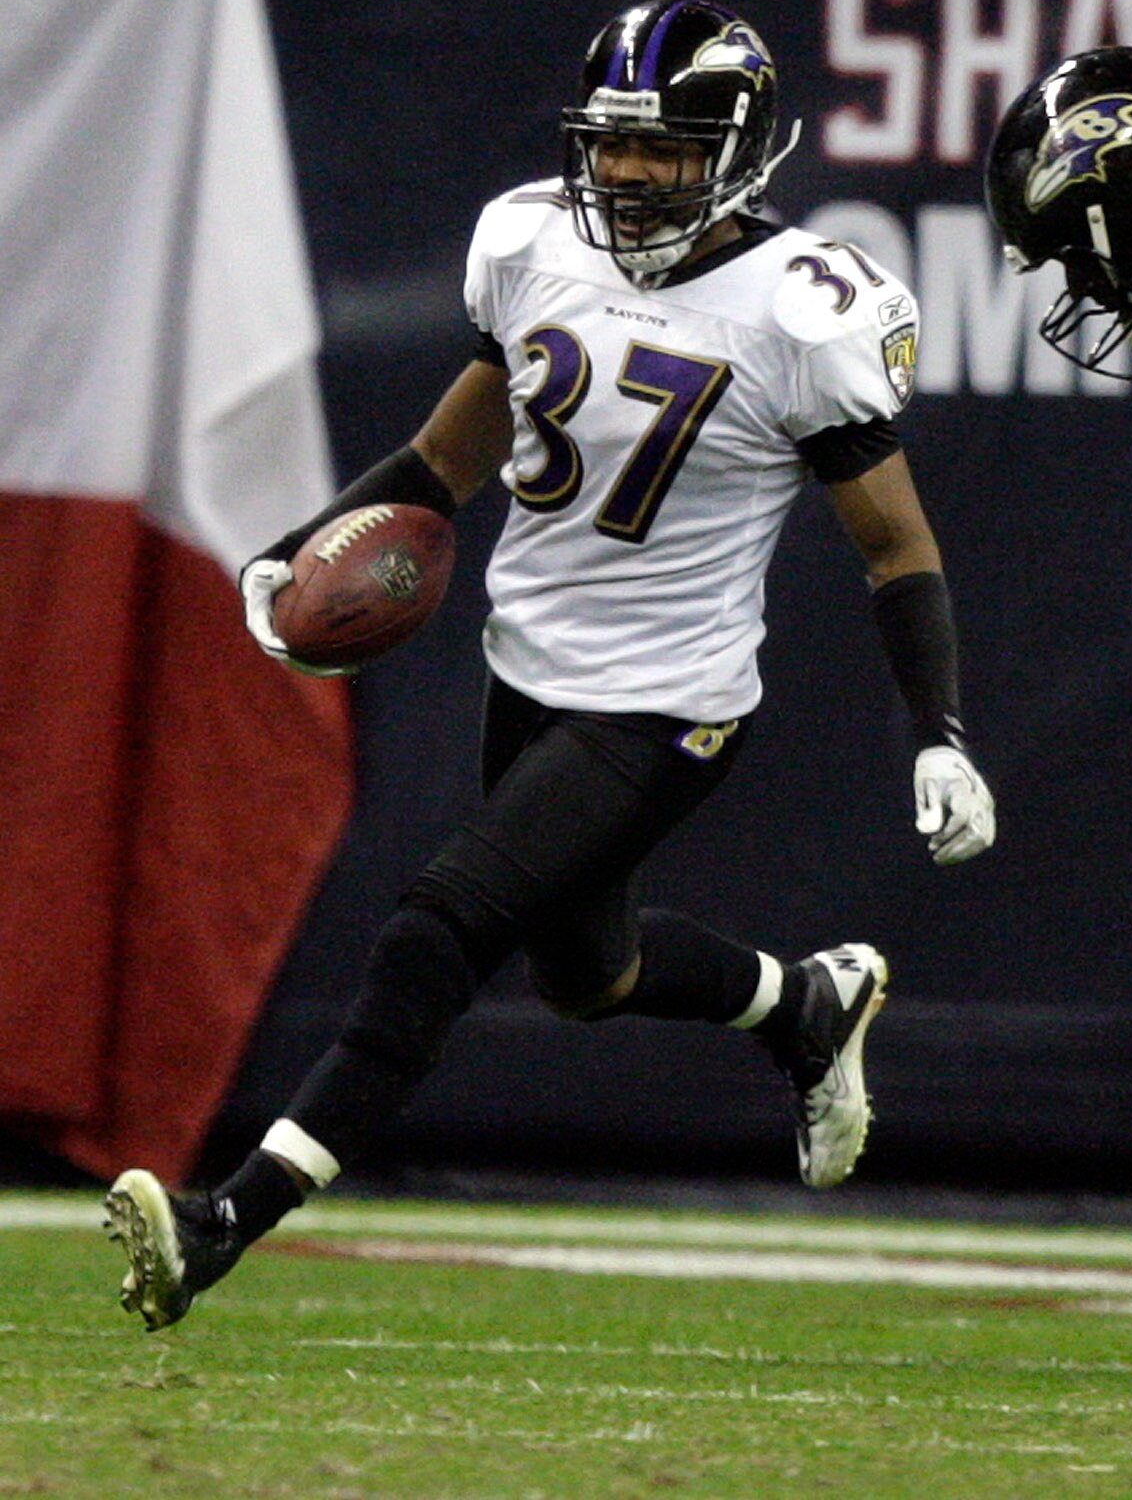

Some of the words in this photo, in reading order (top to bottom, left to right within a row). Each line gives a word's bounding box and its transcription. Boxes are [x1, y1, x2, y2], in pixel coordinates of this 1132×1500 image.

[784, 240, 887, 316] 37
[604, 305, 667, 329] RAVENS
[511, 323, 735, 543] 37
